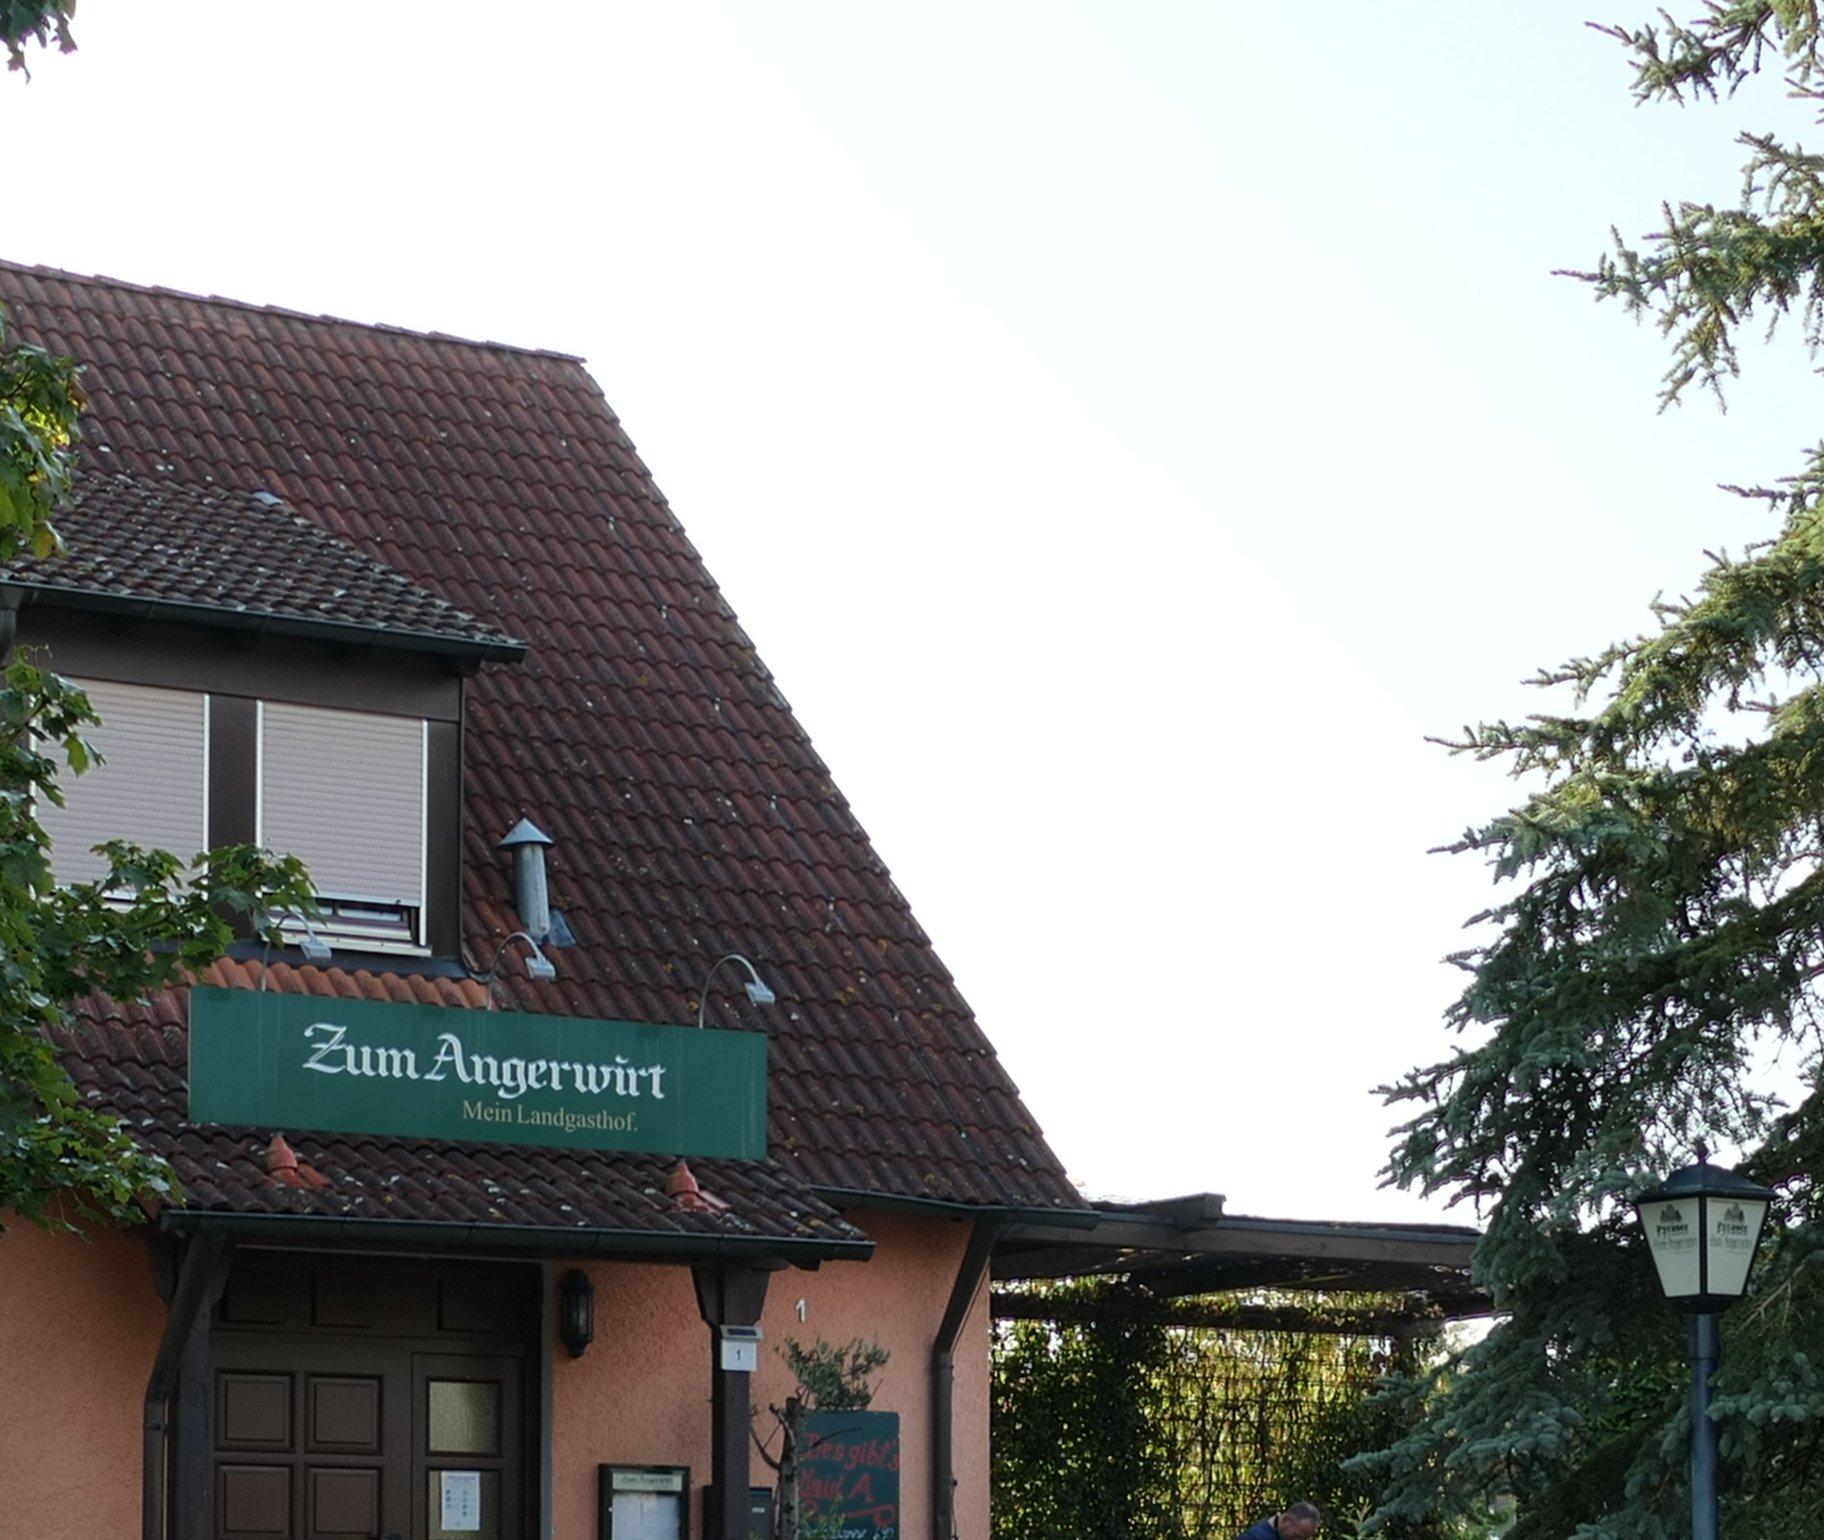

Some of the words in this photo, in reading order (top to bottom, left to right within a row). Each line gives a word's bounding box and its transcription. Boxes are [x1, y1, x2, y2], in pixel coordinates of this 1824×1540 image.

[302, 1022, 420, 1080] Zum
[423, 1032, 666, 1099] Angerwirt
[462, 1100, 513, 1123] Mein
[517, 1104, 639, 1133] Landgasthof.
[795, 1298, 806, 1323] 1
